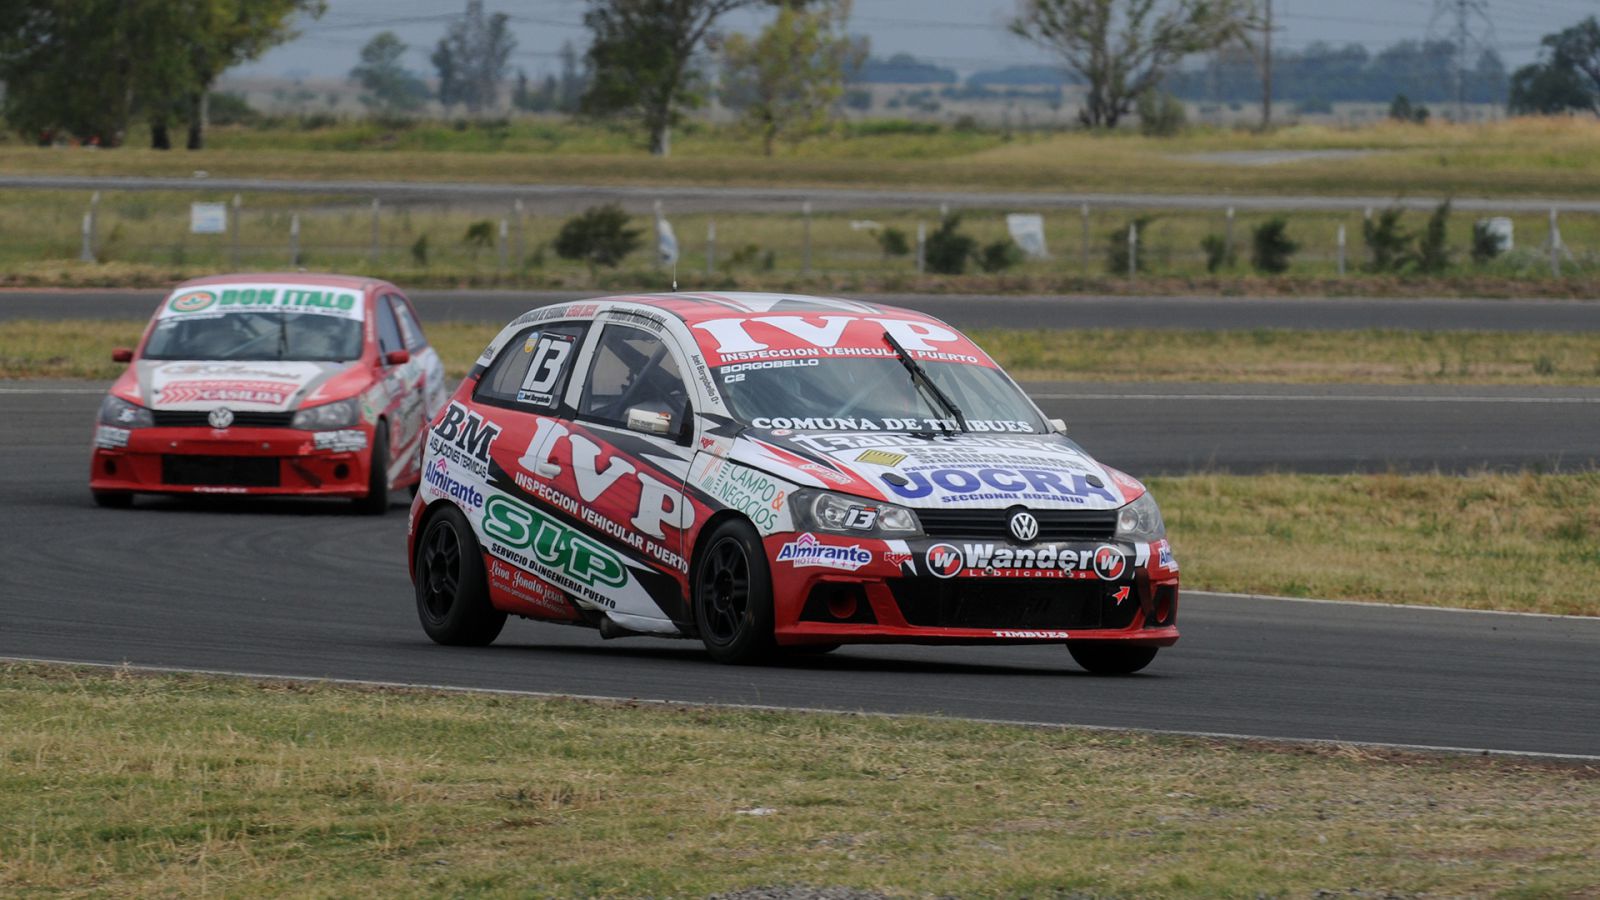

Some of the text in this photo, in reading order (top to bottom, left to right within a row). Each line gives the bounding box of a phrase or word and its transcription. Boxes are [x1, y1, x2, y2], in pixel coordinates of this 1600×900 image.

[219, 289, 355, 310] DON ITALO
[692, 315, 958, 353] IVP
[521, 338, 571, 393] 13
[720, 347, 819, 362] INSPECCION
[917, 350, 978, 363] PUERTO
[720, 359, 819, 374] BORGOBELLO
[724, 374, 746, 383] C2
[202, 389, 282, 404] CASILDA
[435, 404, 498, 463] BM
[751, 417, 880, 431] COMUNA
[881, 418, 923, 431] DE
[425, 460, 483, 508] Almirante
[518, 417, 696, 541] IVP
[730, 465, 776, 502] CAMPO
[719, 481, 778, 530] NEGOCIOS
[942, 493, 1084, 504] SECCIONAL ROSARIO
[515, 472, 688, 575] INSPECCION VEHICULAR PUERTO
[845, 509, 876, 528] 13
[483, 495, 628, 588] SUP
[779, 543, 870, 563] Almirante
[963, 544, 1093, 570] Wander
[492, 543, 527, 566] SERVICIO
[584, 588, 616, 609] PUERTO
